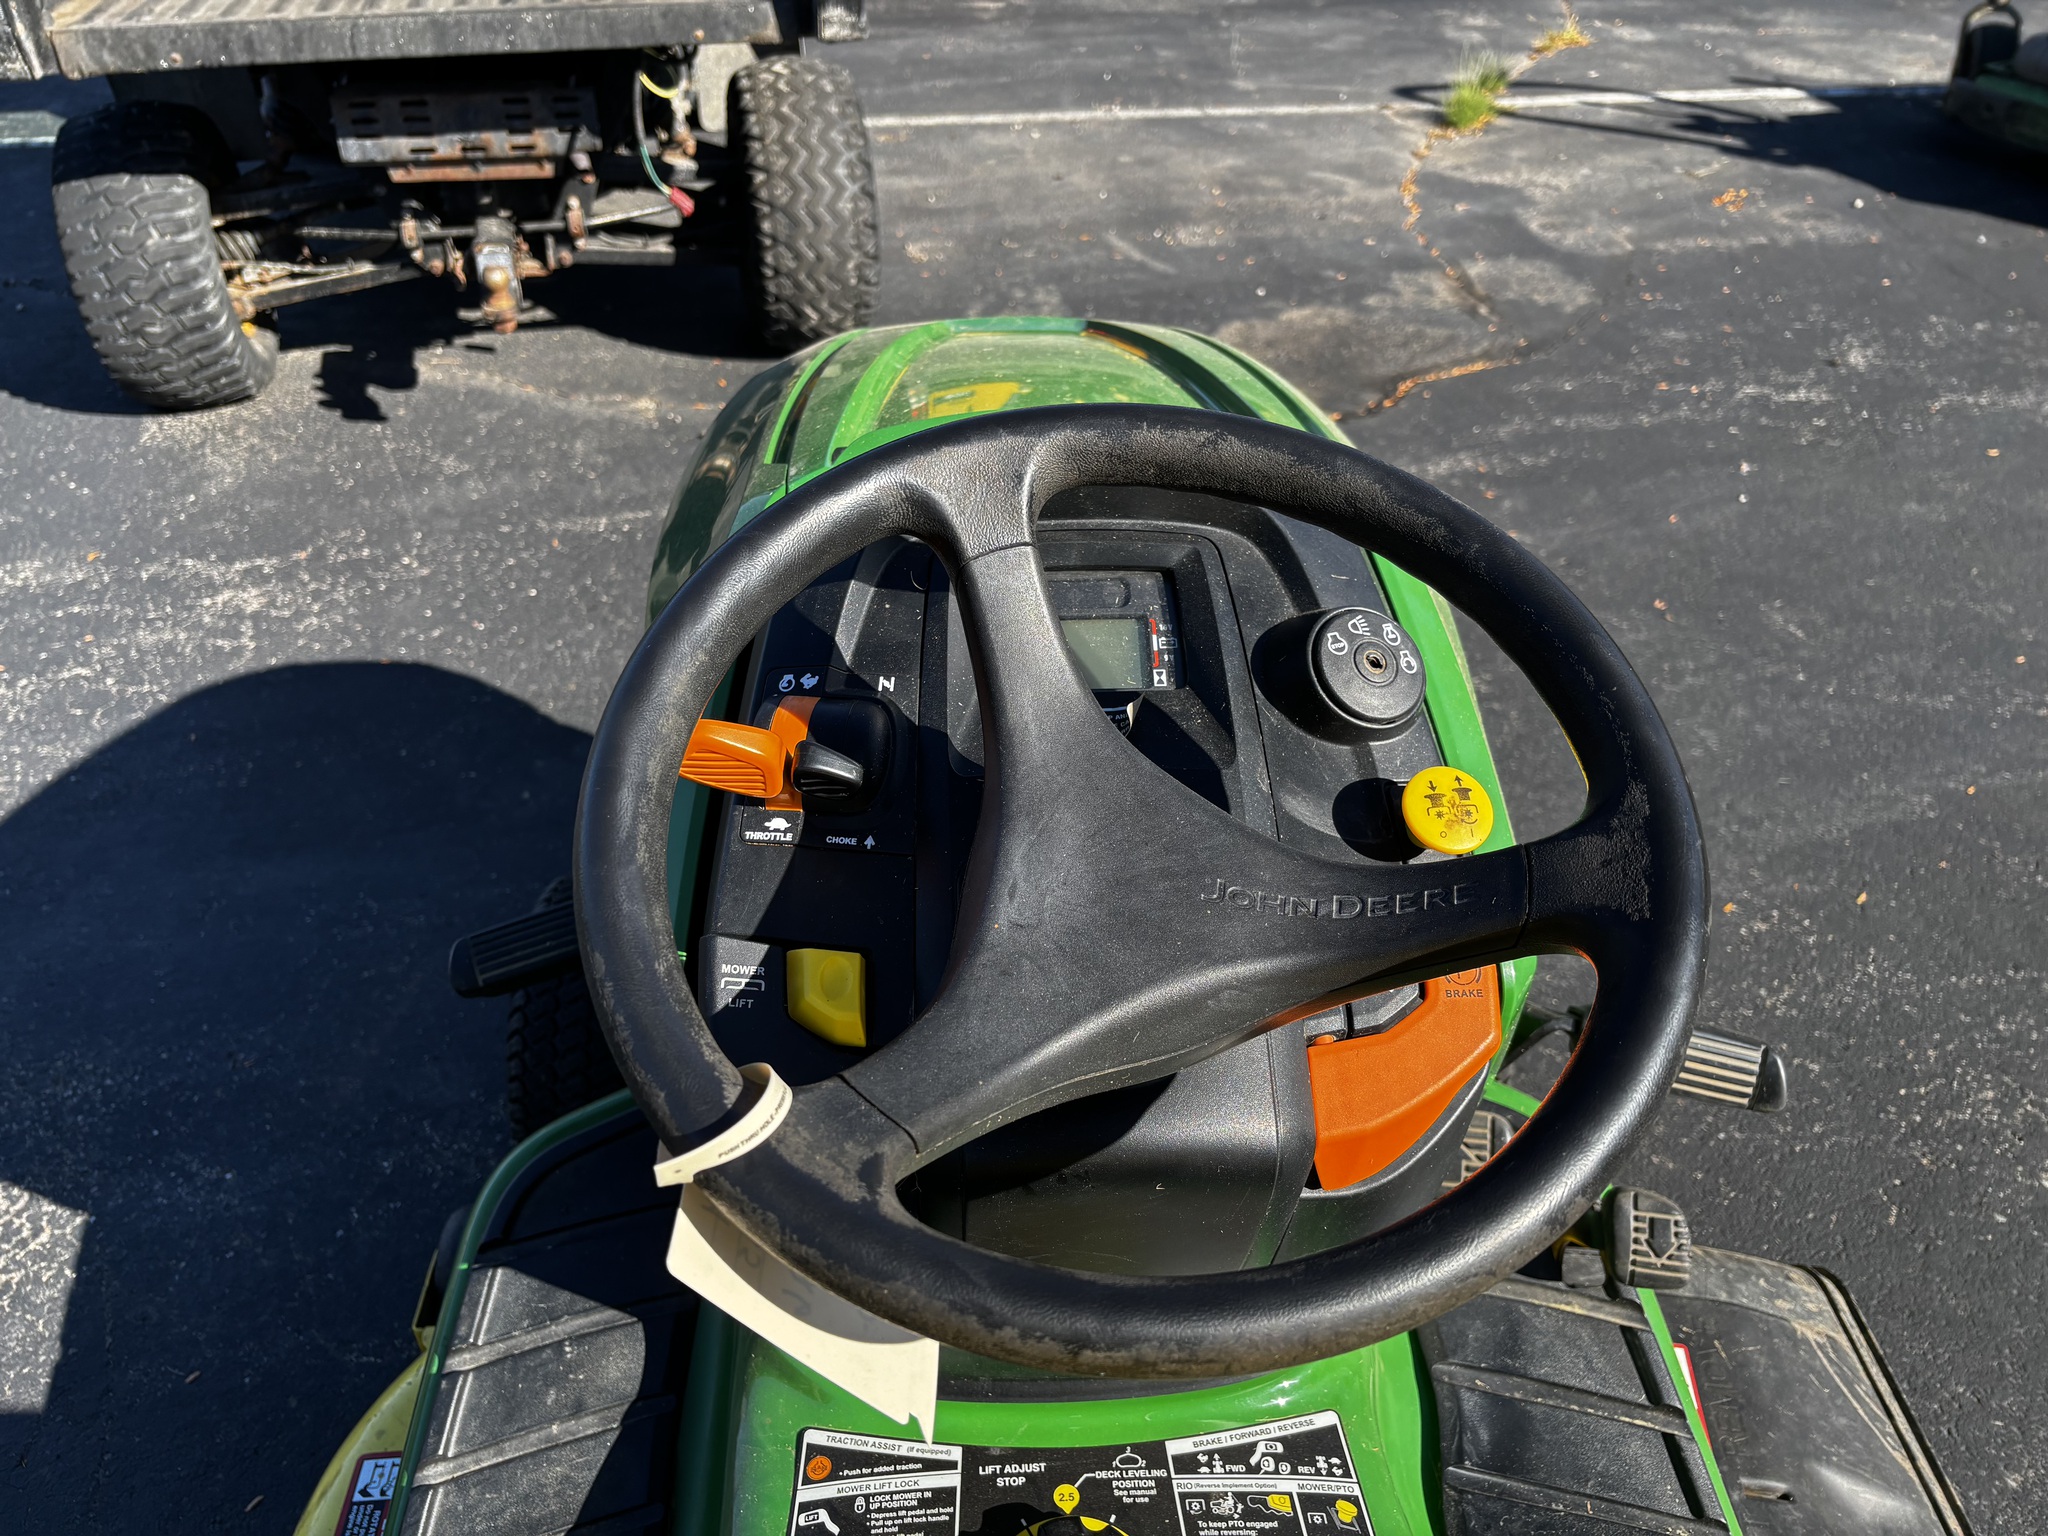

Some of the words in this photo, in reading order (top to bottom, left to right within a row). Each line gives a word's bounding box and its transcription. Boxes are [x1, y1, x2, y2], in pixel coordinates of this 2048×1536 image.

[744, 831, 793, 841] THROTTLE
[826, 835, 858, 846] CHOKE
[1200, 878, 1319, 919] JOHN
[1332, 881, 1480, 919] DEERE
[721, 963, 765, 976] MOWER
[1445, 989, 1484, 998] BRAKE
[728, 997, 754, 1009] LIFT
[1192, 1436, 1223, 1449] BRAKE
[1229, 1427, 1272, 1441] FORWARD
[1278, 1418, 1316, 1432] REVERSE
[826, 1435, 869, 1447] TRACTION
[870, 1441, 902, 1452] ASSIST
[1141, 1459, 1147, 1467] 2
[1225, 1464, 1246, 1472] FWD
[843, 1467, 861, 1477] Push
[862, 1465, 872, 1474] for
[873, 1463, 895, 1473] added
[896, 1462, 923, 1471] traction
[978, 1464, 1002, 1475] LIFT
[1003, 1463, 1046, 1473] ADJUST
[1095, 1470, 1121, 1479] DECK
[1122, 1469, 1168, 1478] LEVELING
[1297, 1465, 1316, 1474] REV
[996, 1476, 1026, 1487] STOP
[1112, 1479, 1156, 1488] POSITION
[1176, 1481, 1193, 1490] RIO
[837, 1483, 871, 1494] MOWER
[874, 1481, 892, 1490] LIFT
[895, 1480, 920, 1489] LOCK
[1129, 1488, 1157, 1496] manual
[1297, 1483, 1355, 1493] MOWER/PTO
[869, 1494, 892, 1502] LOCK
[892, 1491, 923, 1500] MOWER
[1058, 1493, 1075, 1502] 2.5
[881, 1499, 918, 1509] POSITION
[870, 1511, 897, 1519] Depress
[1208, 1520, 1227, 1529] keep
[1245, 1520, 1279, 1529] engaged
